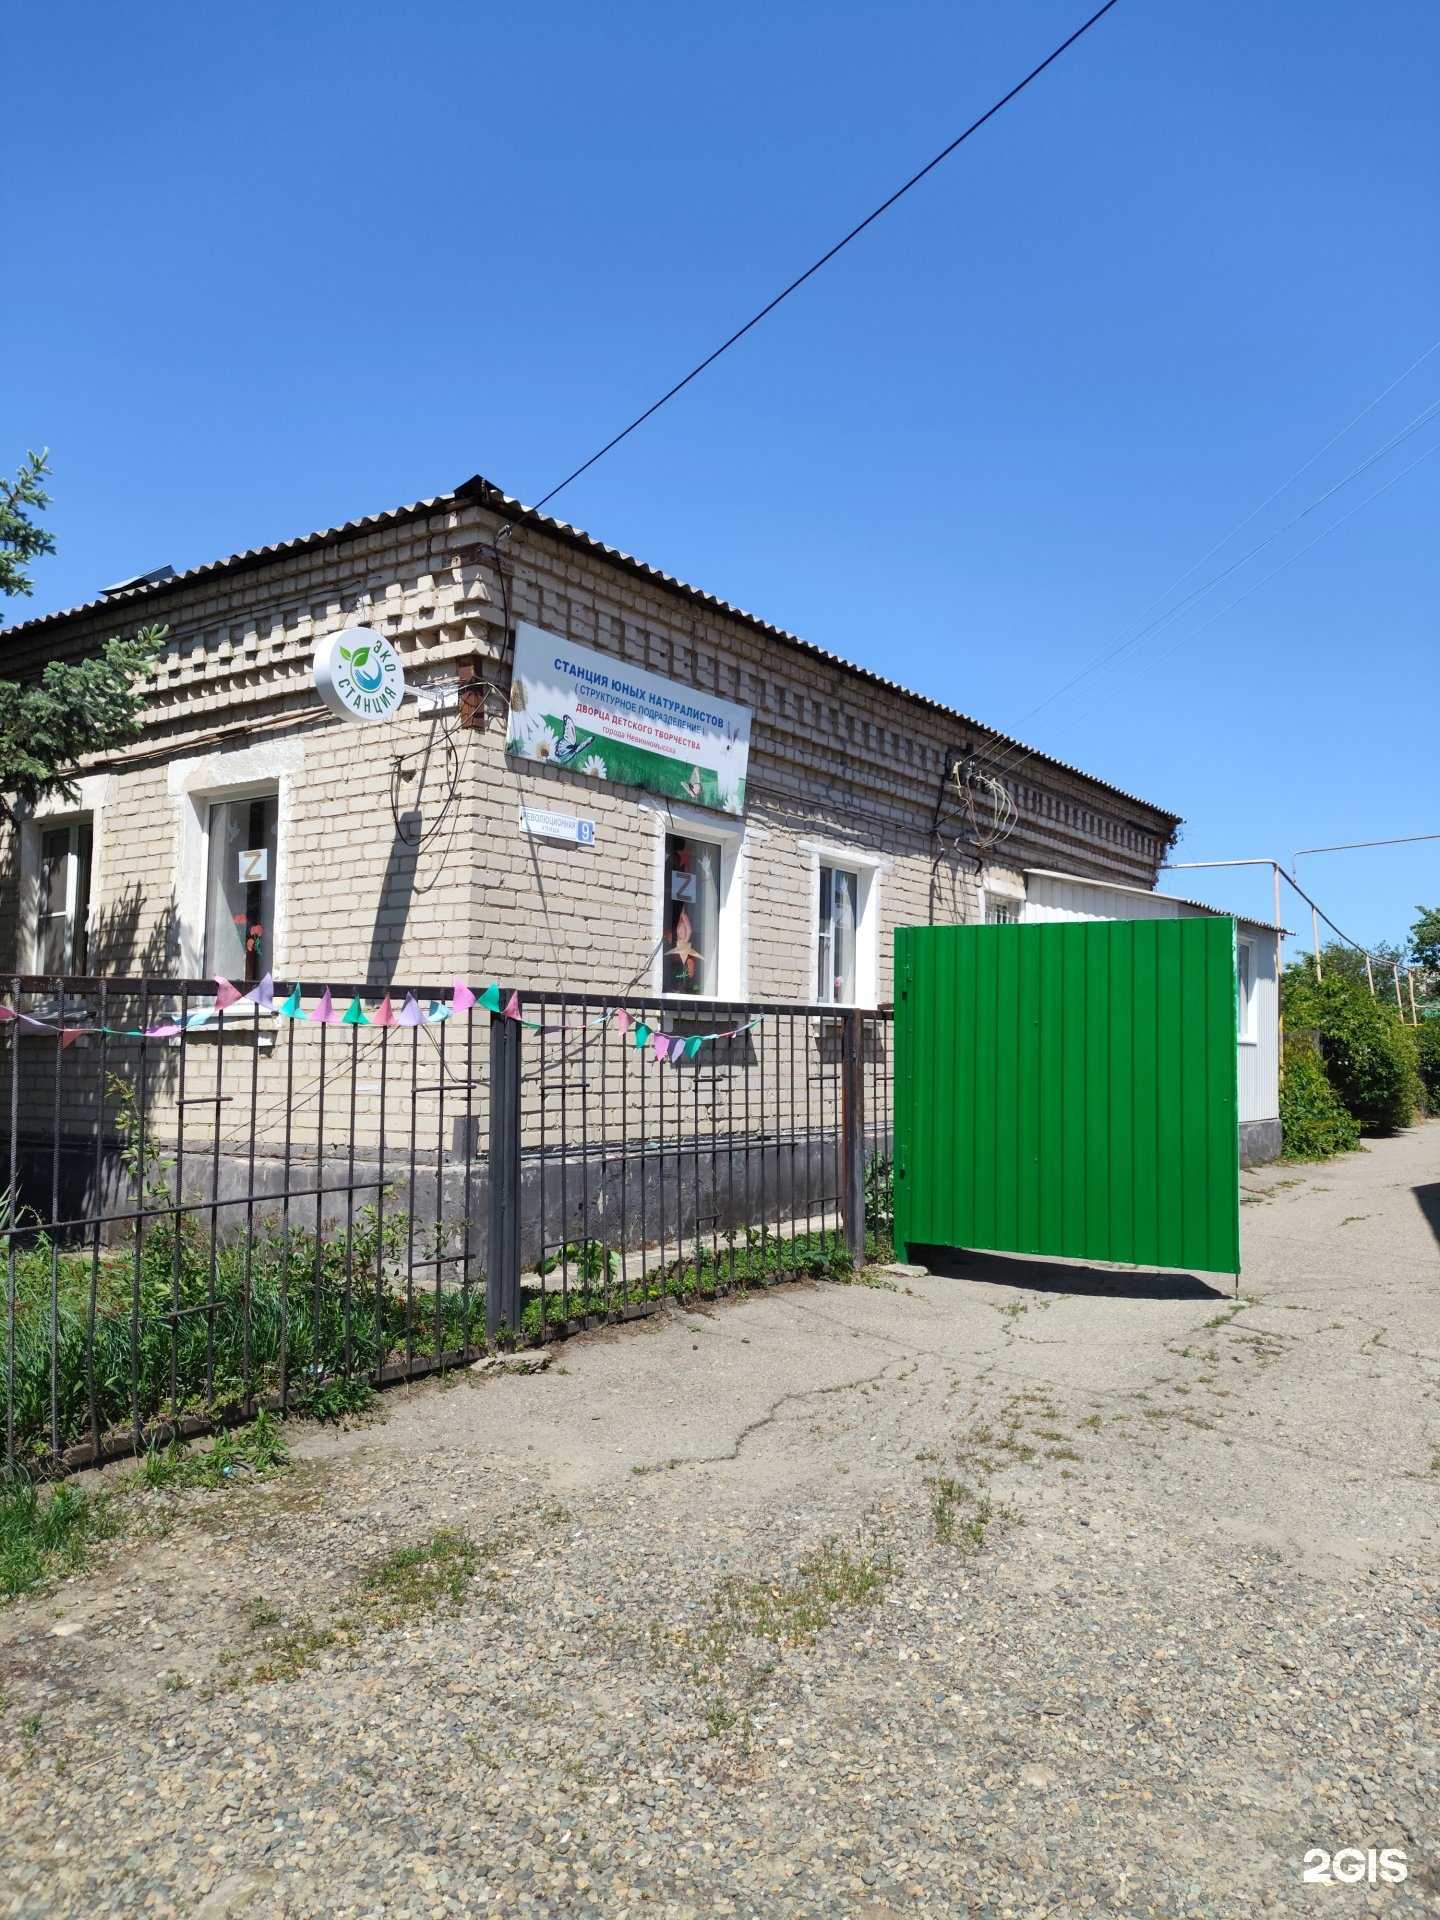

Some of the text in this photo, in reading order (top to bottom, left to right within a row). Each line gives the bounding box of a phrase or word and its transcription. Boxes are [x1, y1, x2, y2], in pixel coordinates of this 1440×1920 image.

[373, 640, 396, 672] ЭКО
[338, 678, 397, 714] СТАНЦИЯ
[553, 658, 724, 728] СТАНЦИЯ ЮНЫХ НАТУРАЛИСТОВ
[576, 703, 701, 751] ДВОРЦА ДЕТСКОГО ТВОРЧЕСТВА
[602, 726, 625, 739] города
[581, 823, 590, 840] 9
[244, 850, 262, 880] Z
[675, 872, 692, 900] Z
